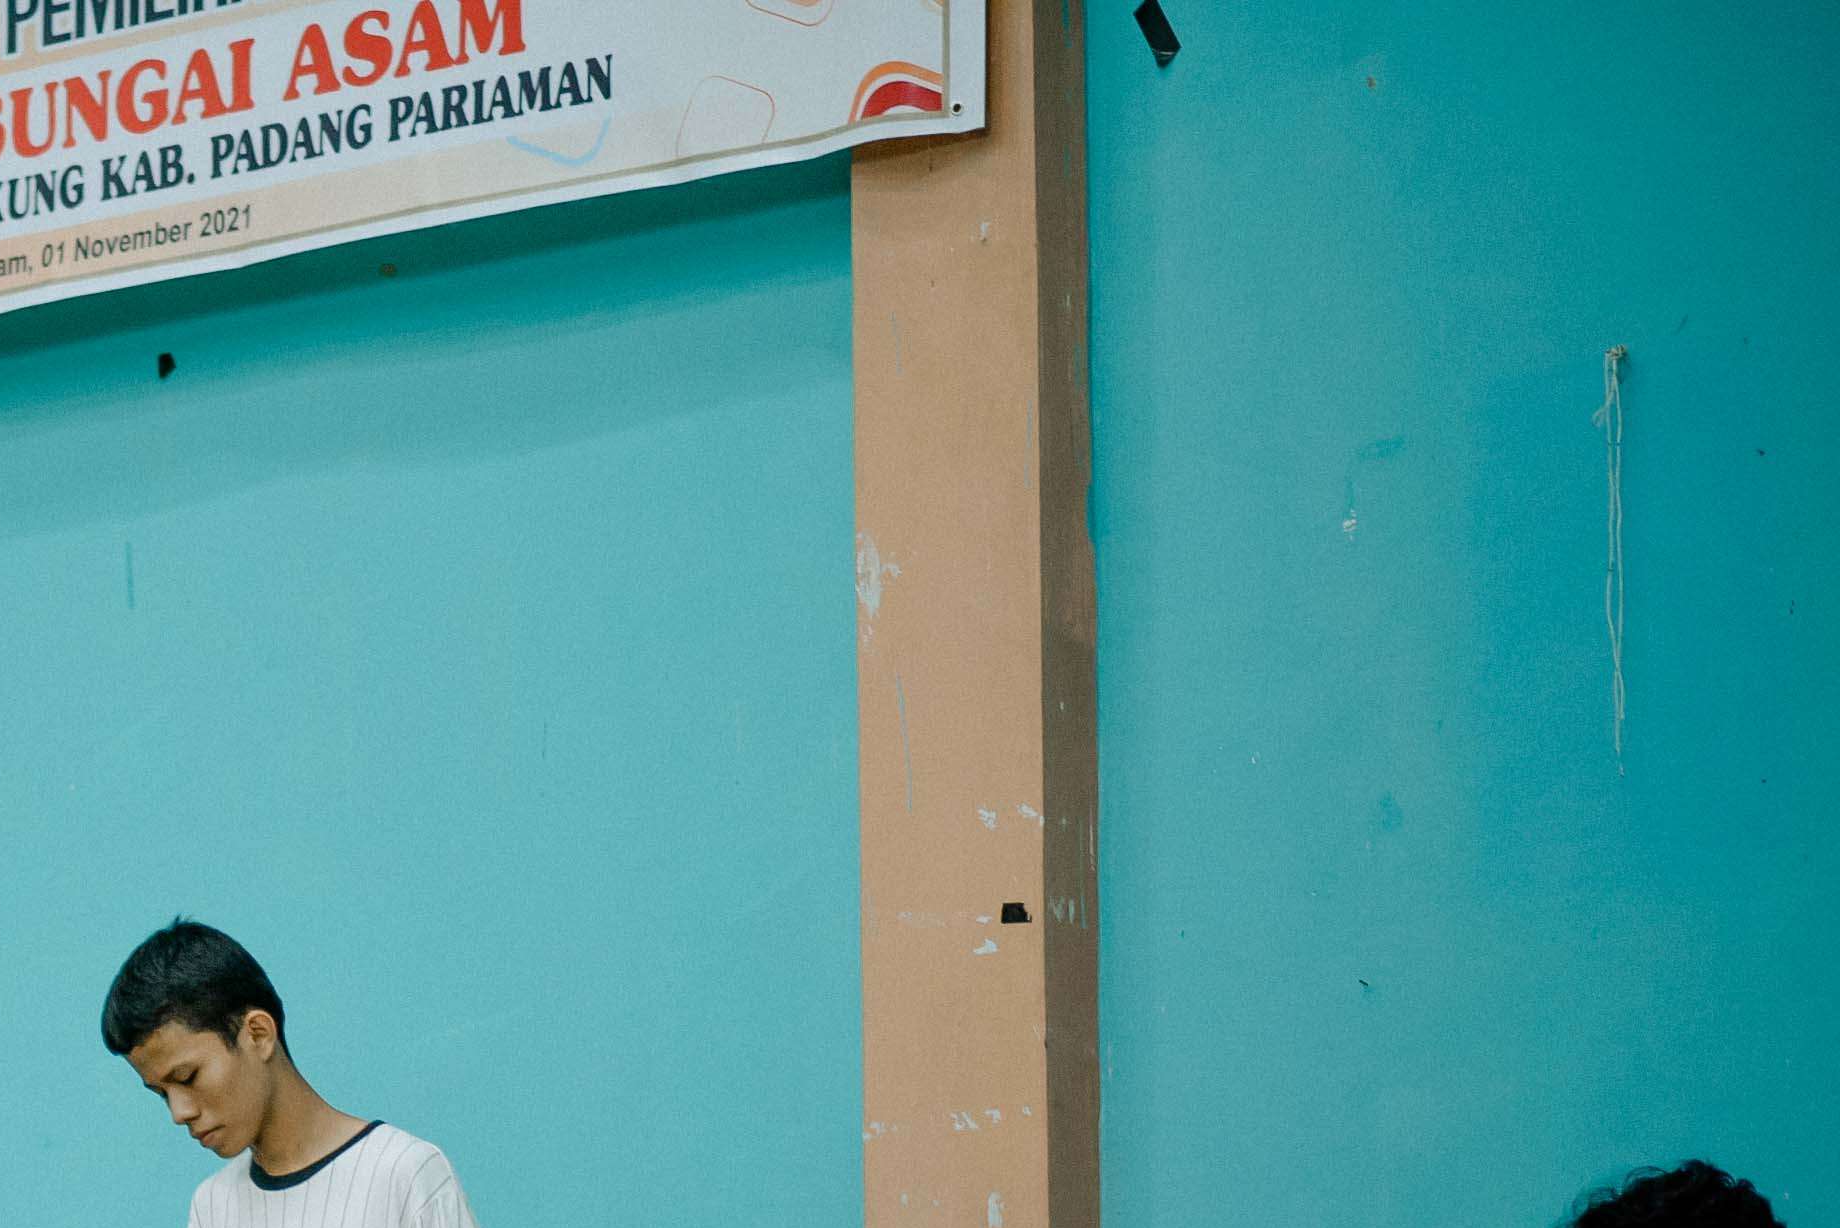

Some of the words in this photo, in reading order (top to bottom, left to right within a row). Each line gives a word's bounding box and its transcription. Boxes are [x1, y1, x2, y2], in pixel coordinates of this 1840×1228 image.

[283, 0, 526, 101] ASAM
[100, 143, 196, 200] KAB.
[209, 103, 373, 179] PADANG
[387, 54, 614, 142] PARIAMAN
[40, 242, 67, 270] 01
[74, 219, 193, 263] November
[198, 203, 254, 238] 2021
